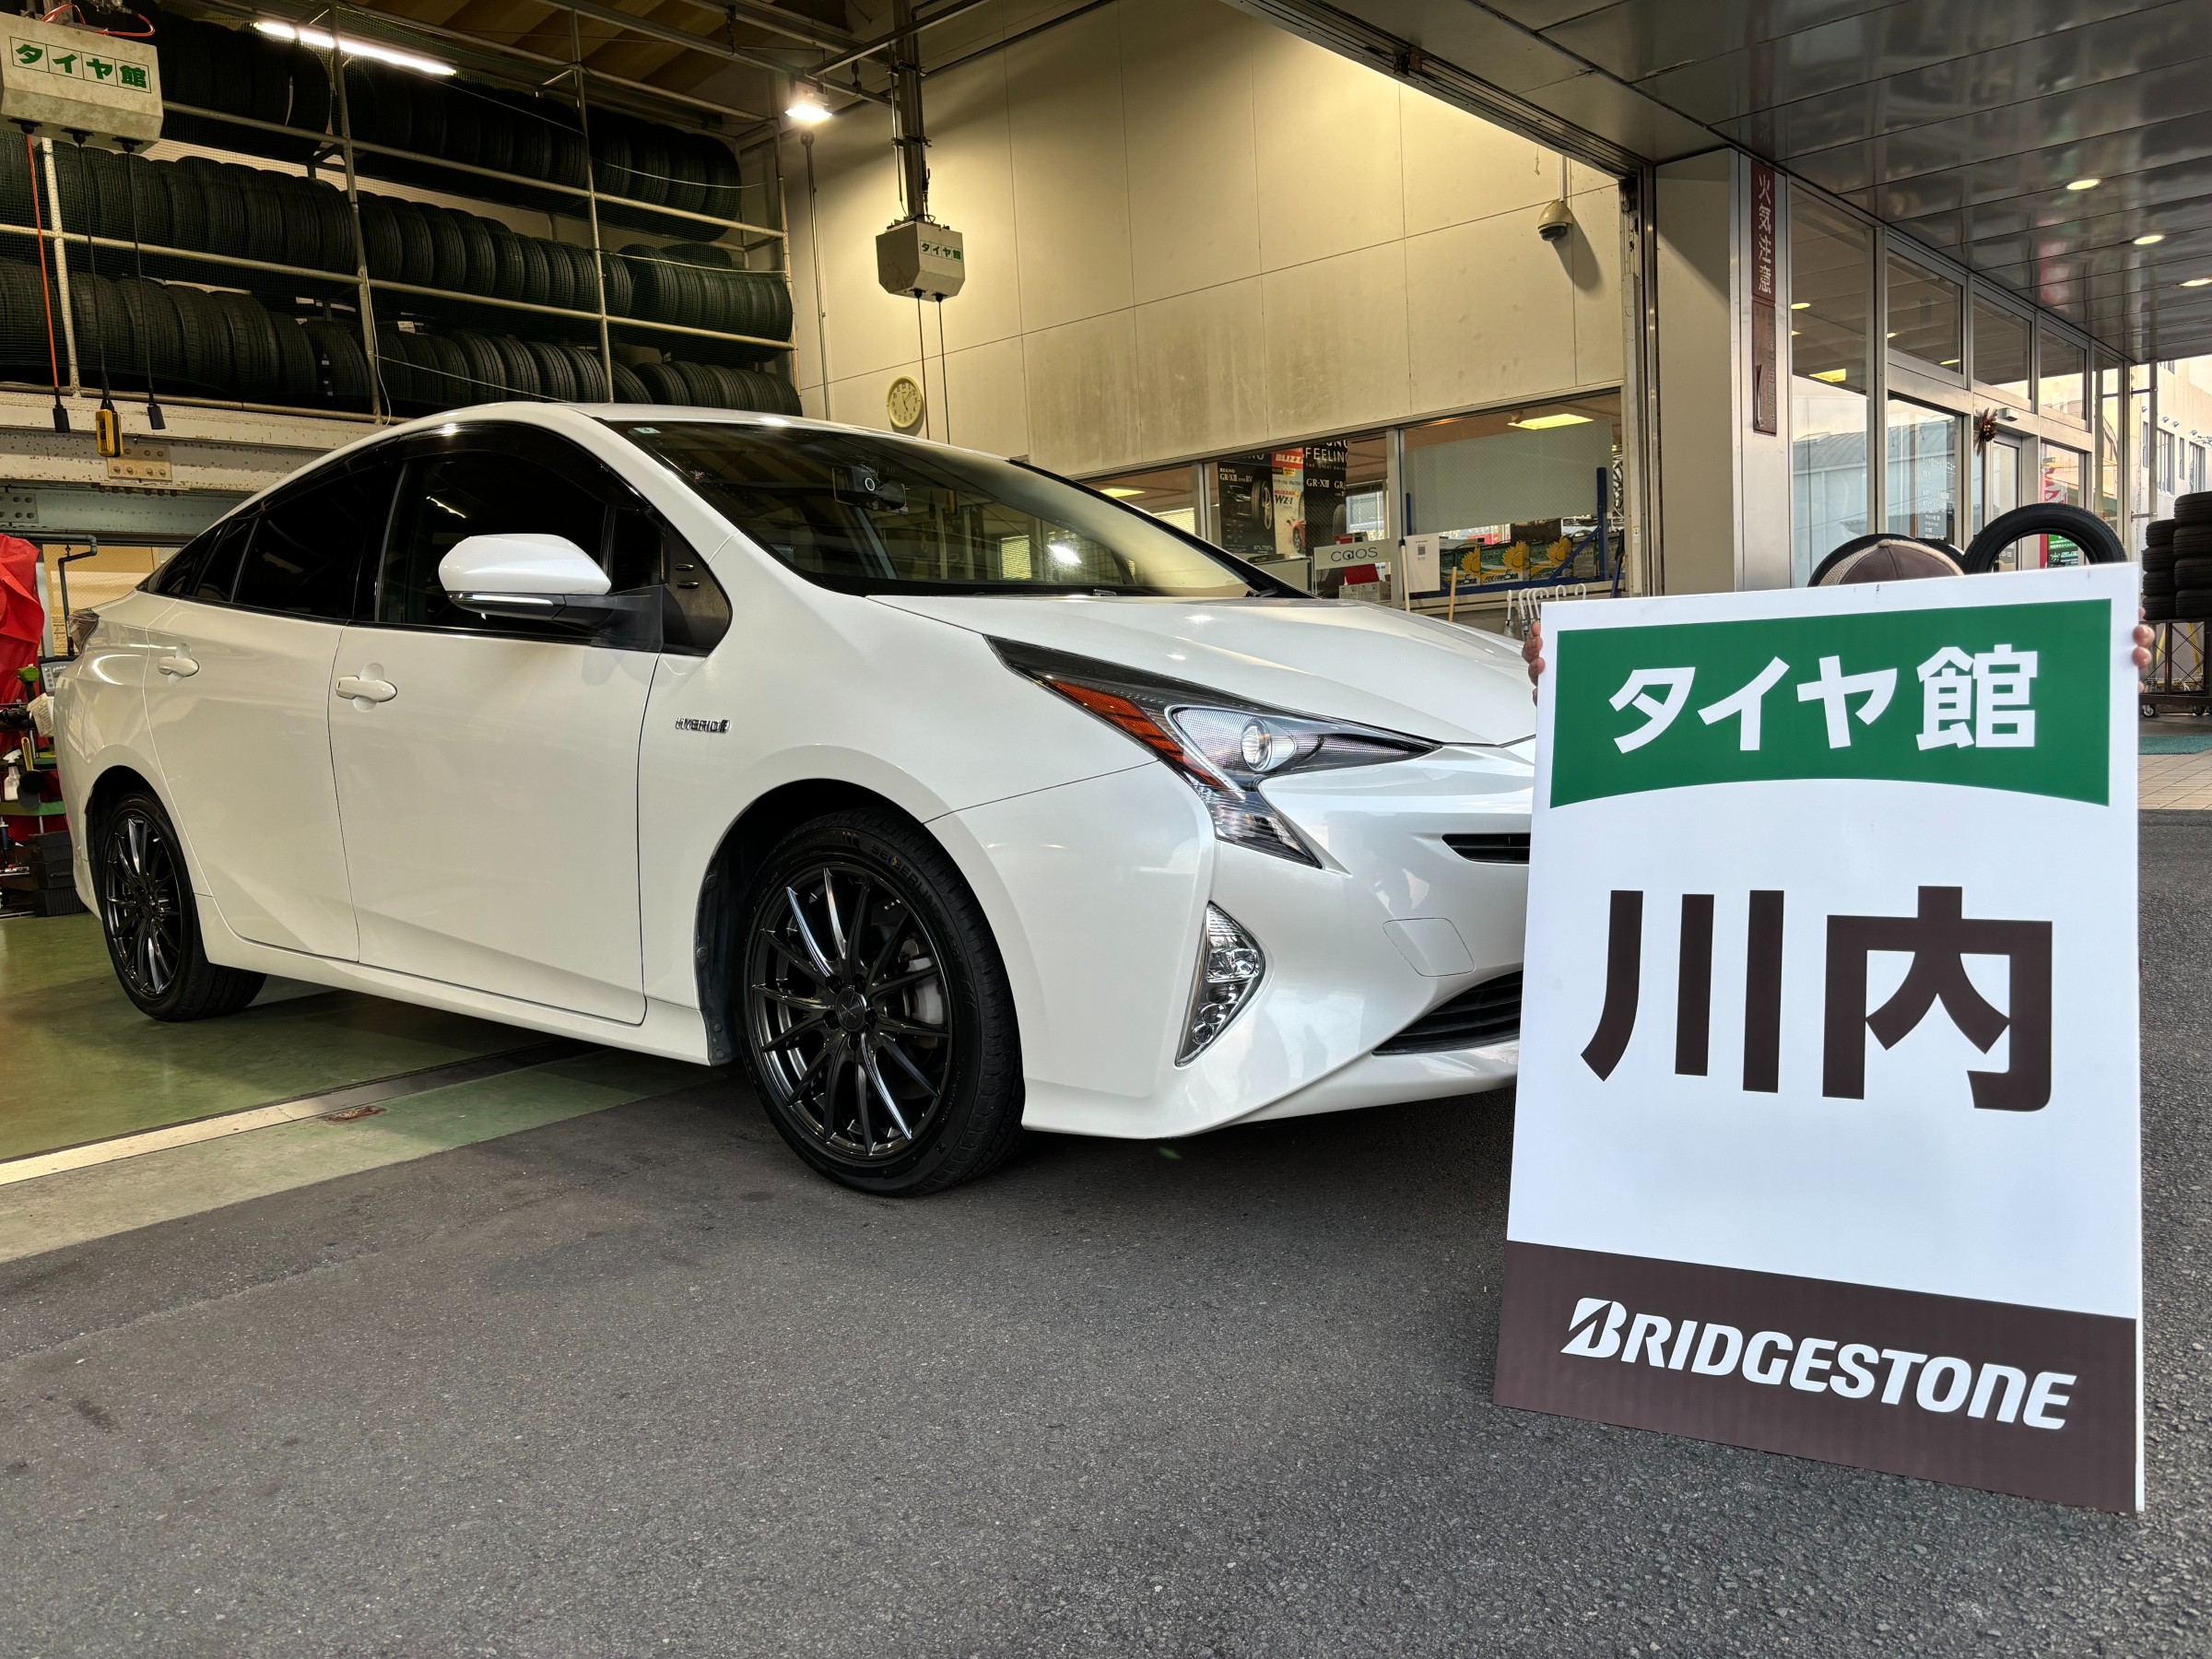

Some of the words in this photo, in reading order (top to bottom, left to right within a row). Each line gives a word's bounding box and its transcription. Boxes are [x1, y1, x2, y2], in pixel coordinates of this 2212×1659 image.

[15, 43, 147, 88] タイヤ館
[922, 242, 961, 260] タイヤ館
[1276, 453, 1303, 465] BLIZZ
[1608, 643, 2039, 755] タイヤ館
[675, 718, 719, 733] HYBRID
[1581, 886, 2053, 1112] 川内
[1560, 1297, 2077, 1430] BRIDGESTONE
